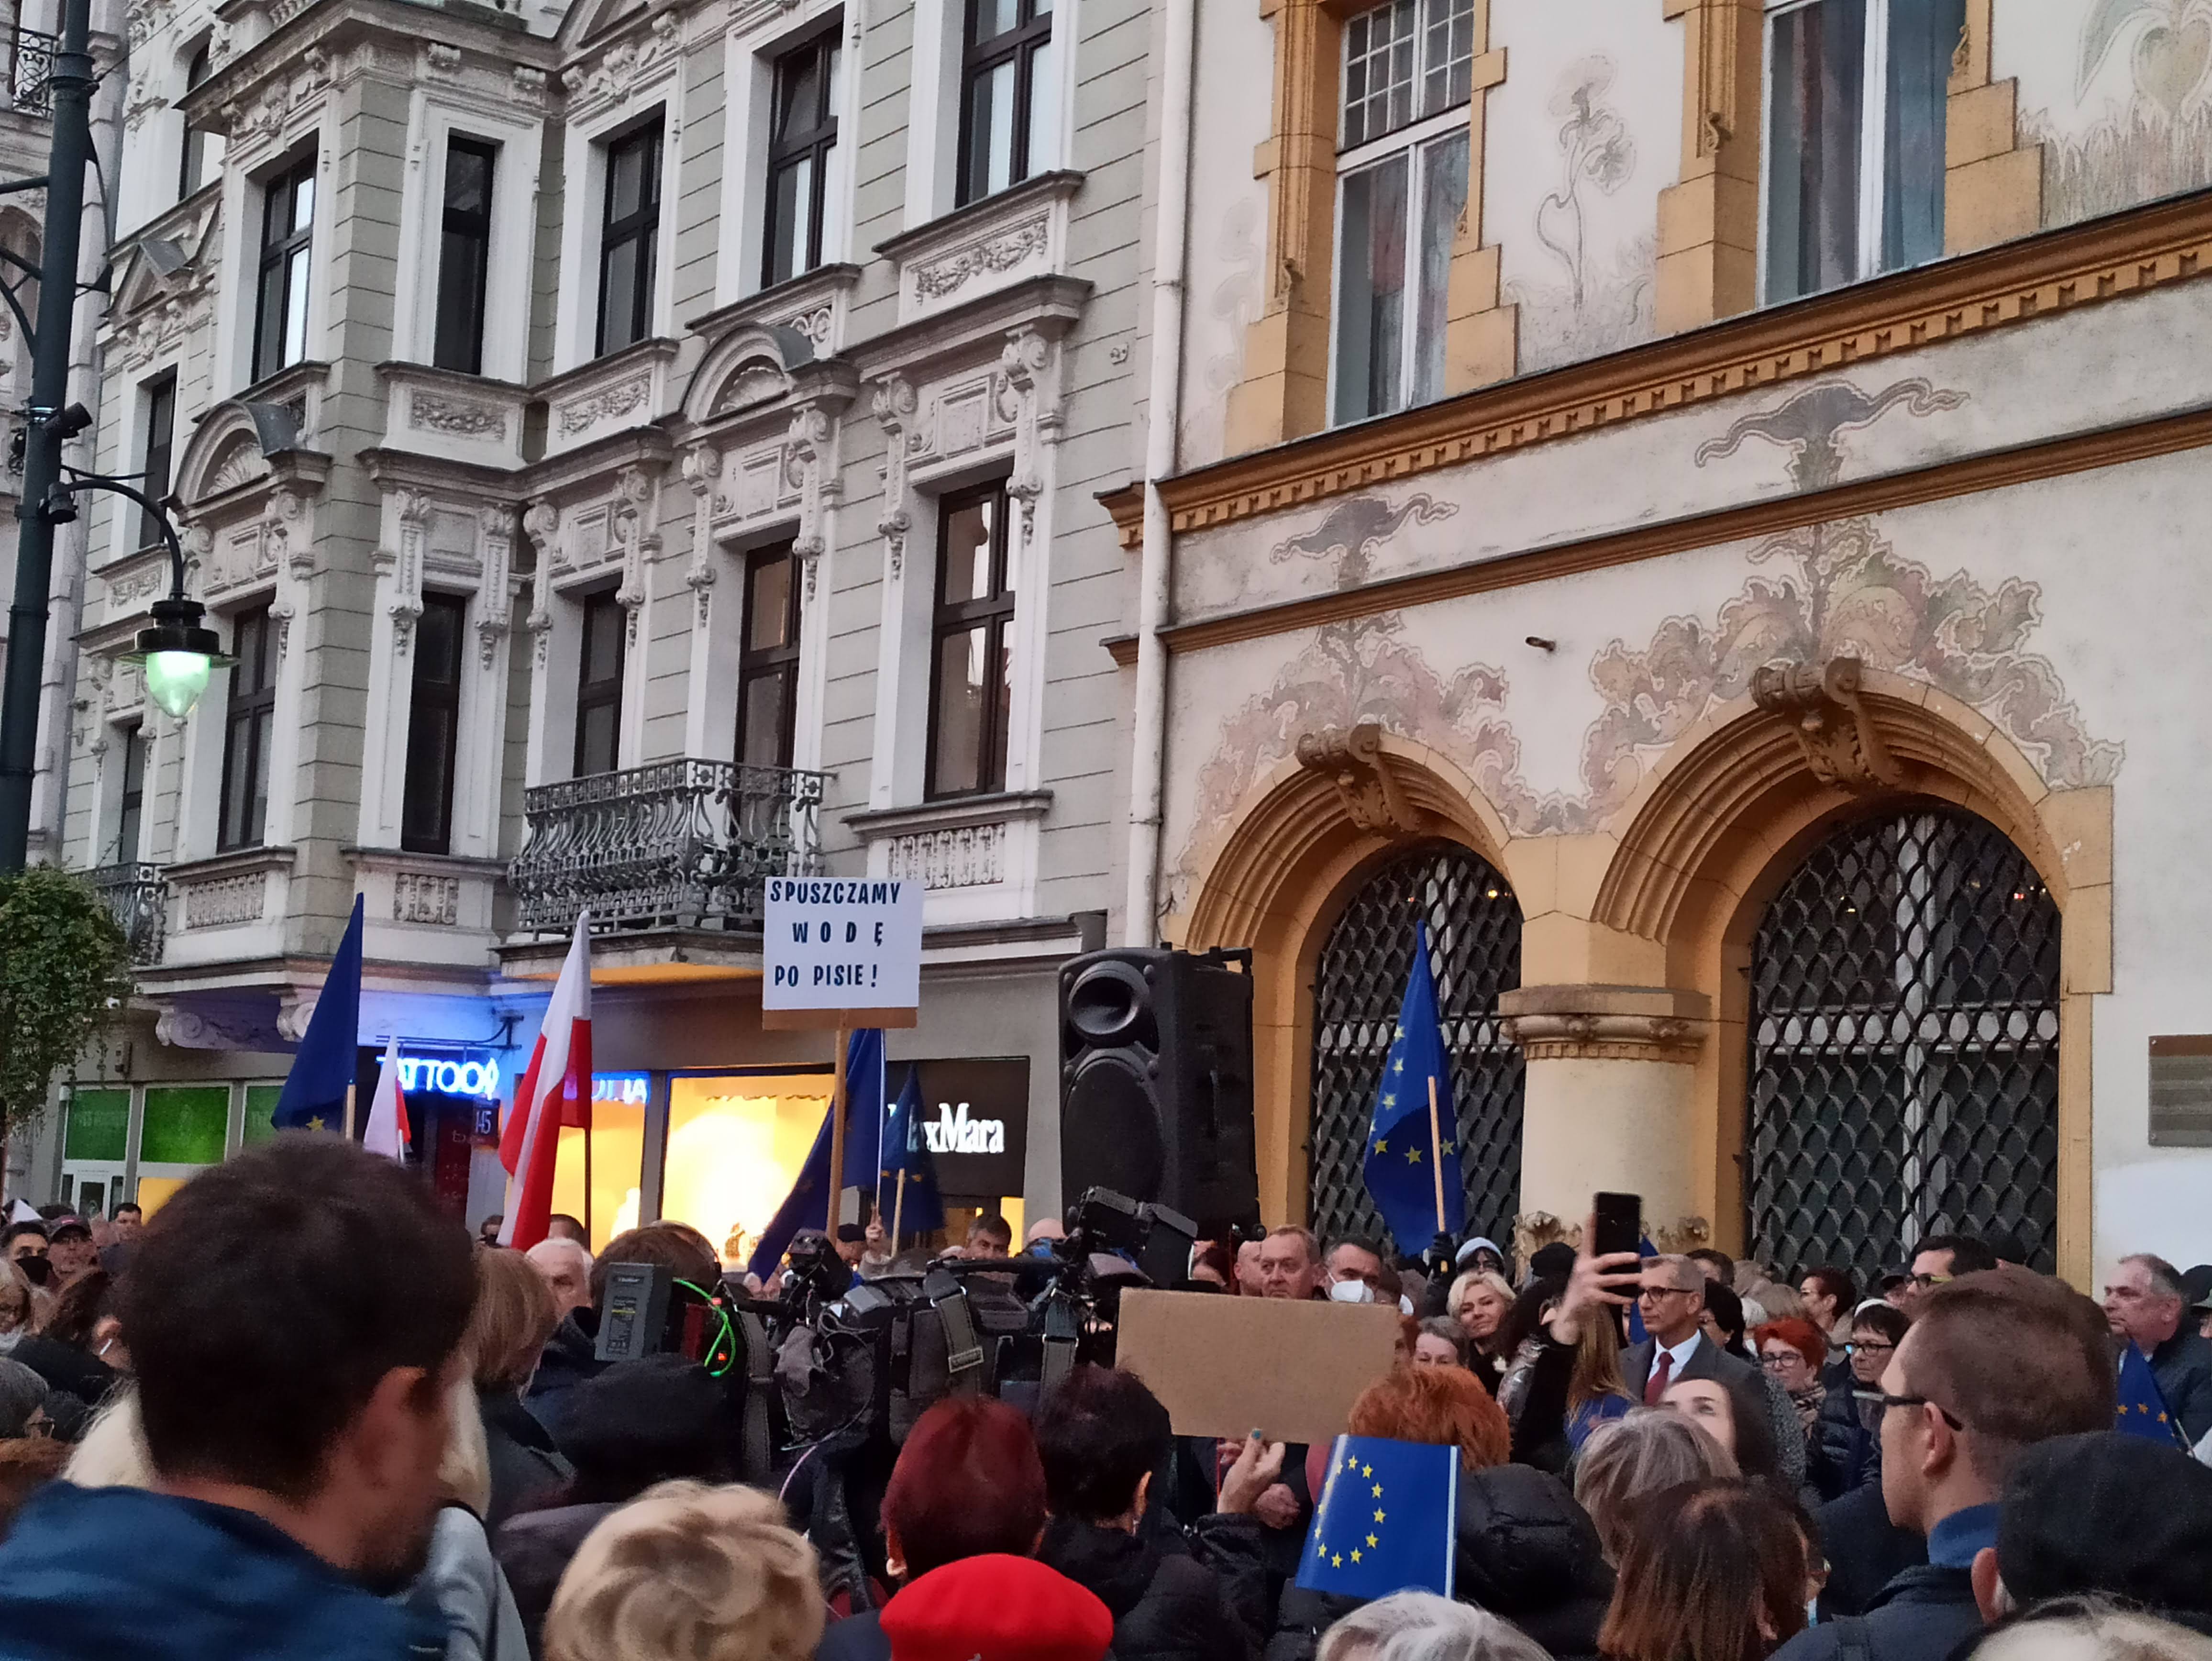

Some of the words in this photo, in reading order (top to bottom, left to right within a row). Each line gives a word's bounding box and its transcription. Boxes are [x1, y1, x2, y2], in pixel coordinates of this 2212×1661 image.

[770, 880, 901, 904] SPUSZCZAMY
[792, 921, 884, 946] WODĘ
[774, 965, 799, 987] PO
[888, 1102, 1004, 1153] xMara
